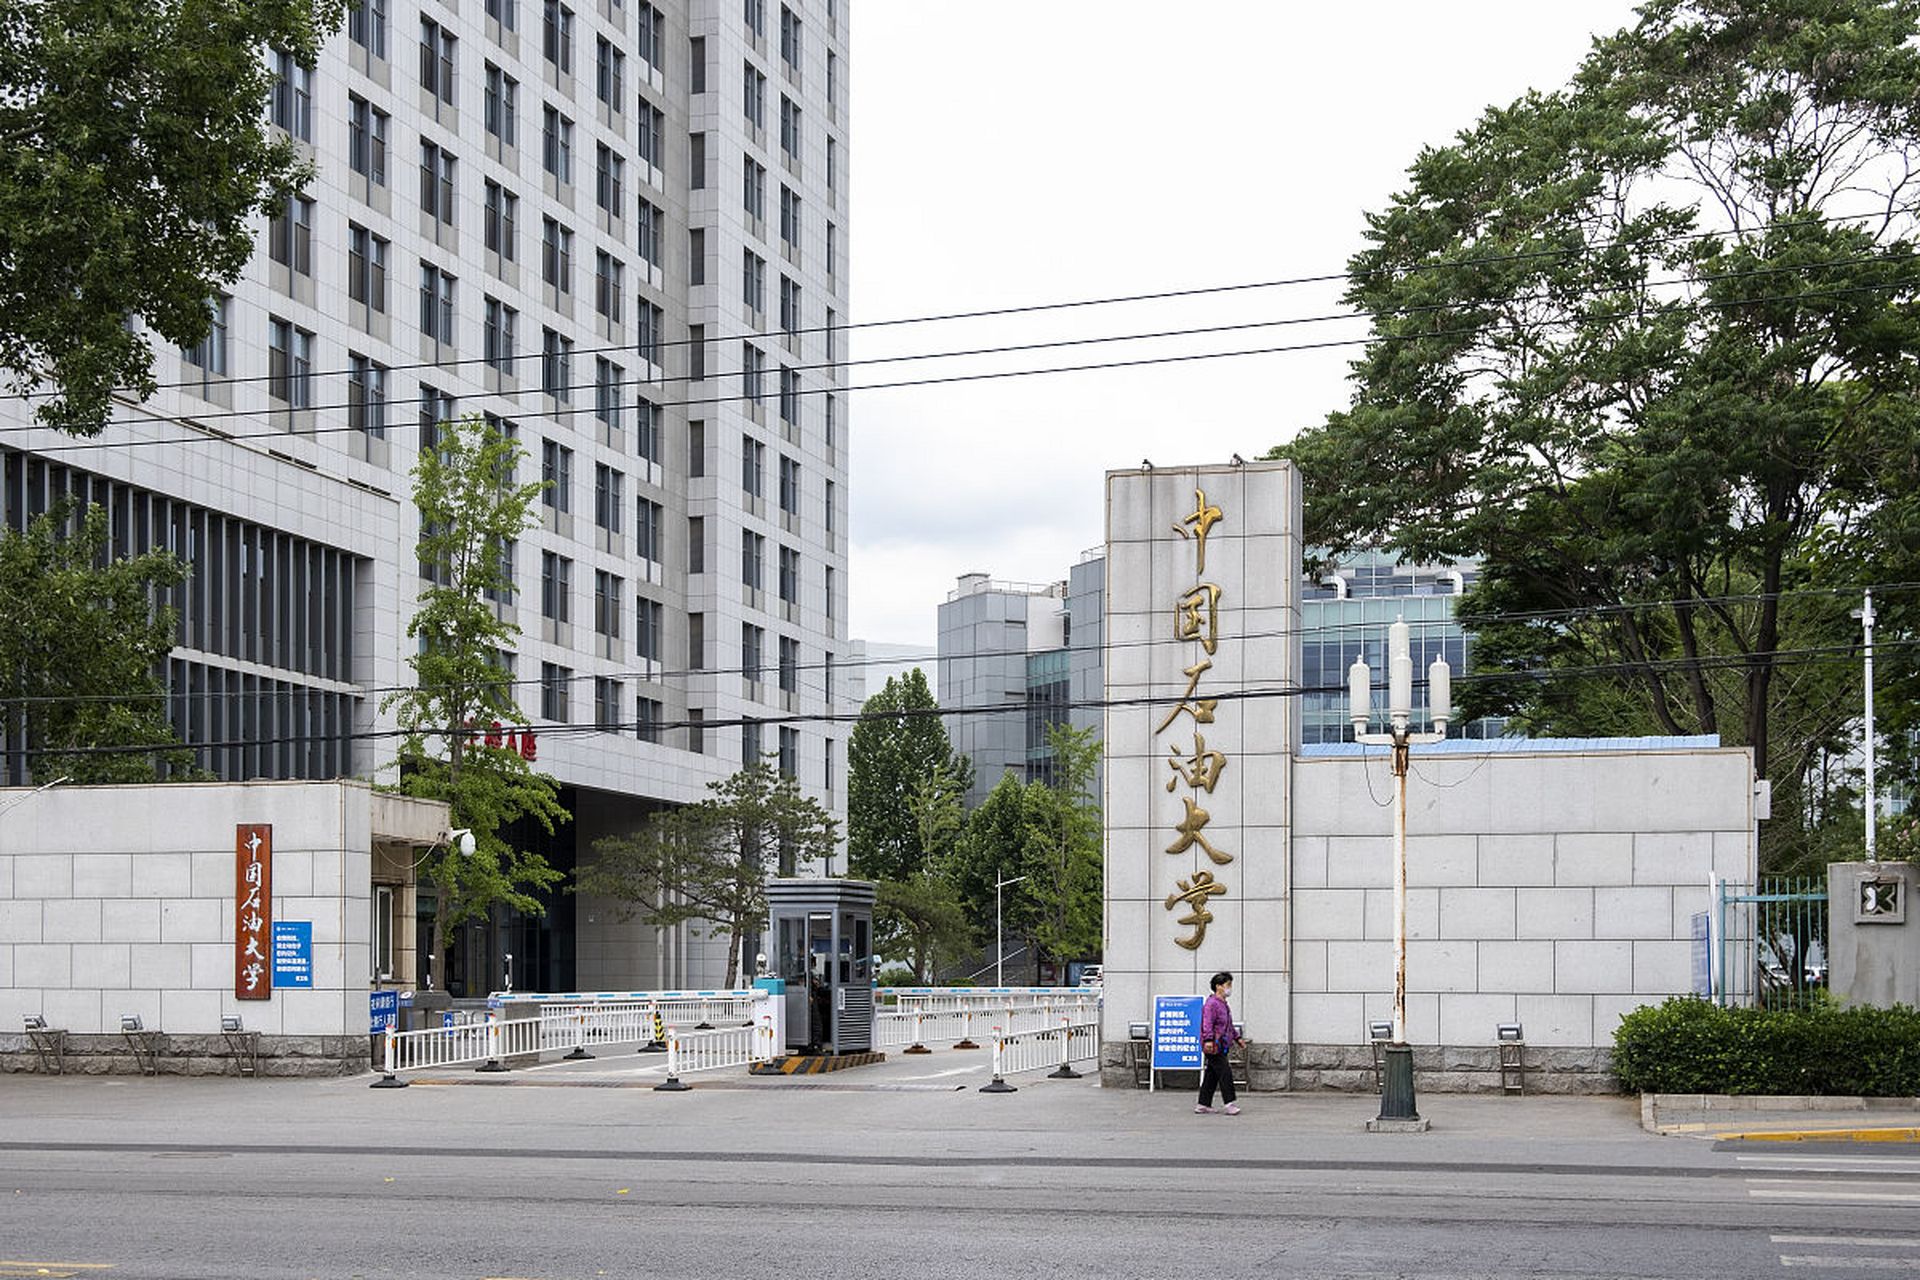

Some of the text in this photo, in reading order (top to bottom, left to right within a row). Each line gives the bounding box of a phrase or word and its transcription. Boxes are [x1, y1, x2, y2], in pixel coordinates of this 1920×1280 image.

[1153, 487, 1234, 951] 中国石油大学
[240, 831, 266, 991] 中国石油大学
